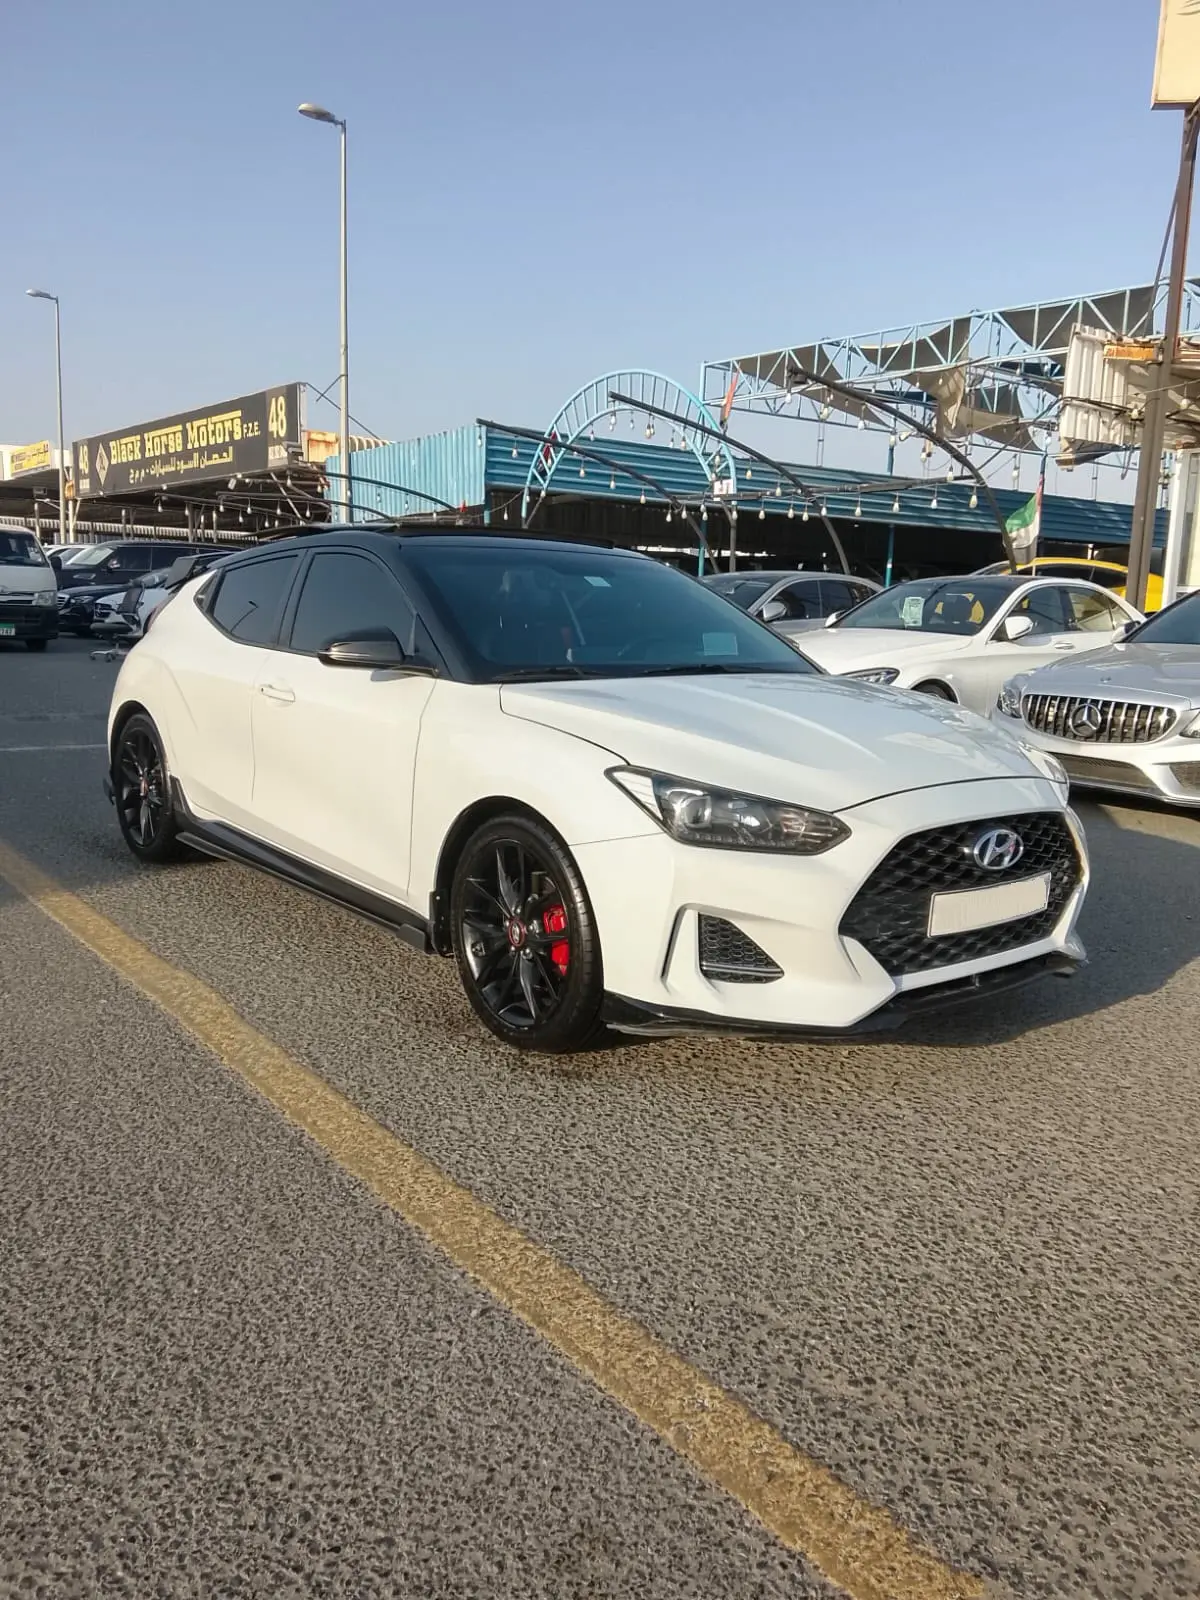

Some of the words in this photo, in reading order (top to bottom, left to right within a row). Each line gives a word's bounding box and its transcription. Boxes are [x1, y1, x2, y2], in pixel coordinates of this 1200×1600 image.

[109, 436, 141, 465] Black
[144, 425, 183, 457] Horse
[185, 411, 242, 449] Motors
[267, 395, 287, 438] 48
